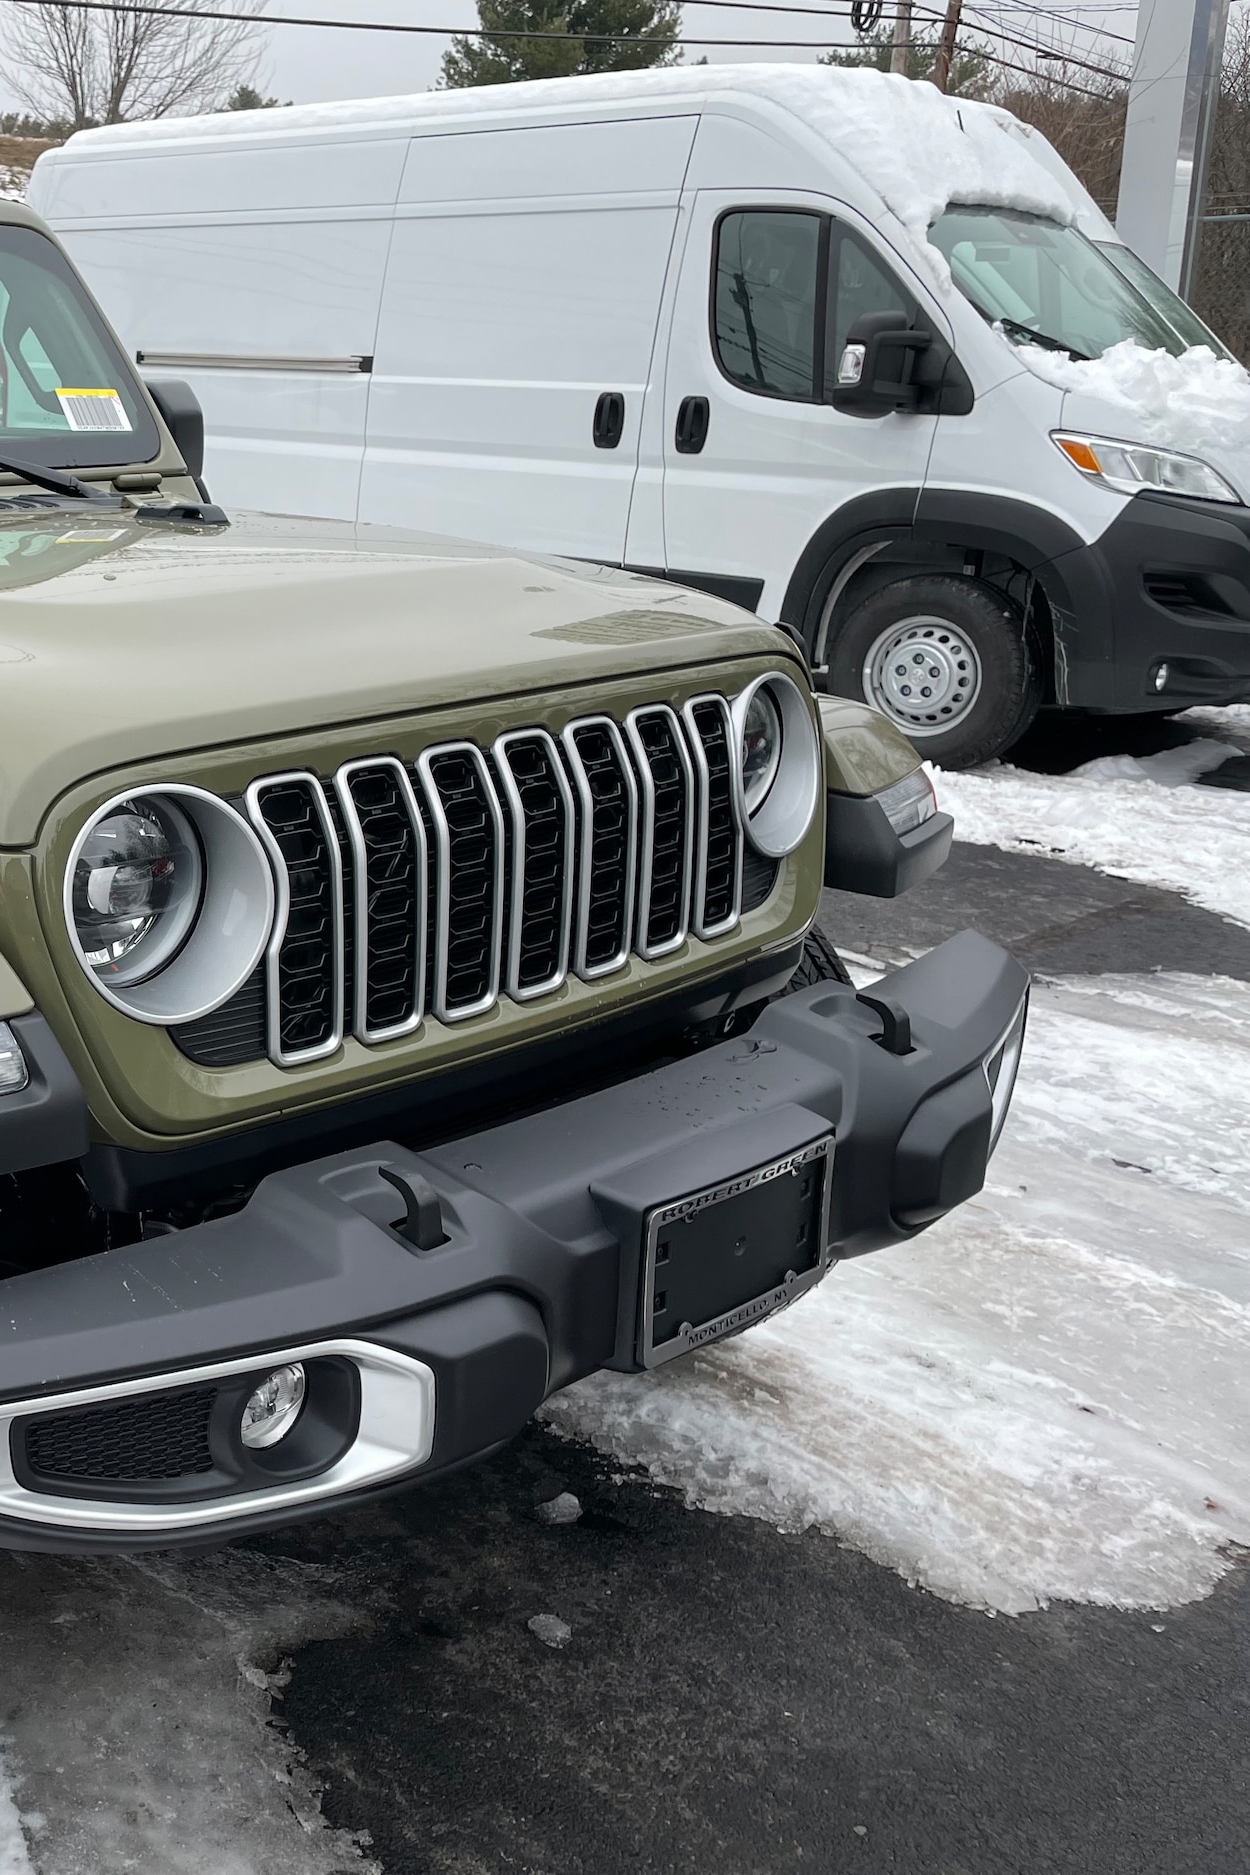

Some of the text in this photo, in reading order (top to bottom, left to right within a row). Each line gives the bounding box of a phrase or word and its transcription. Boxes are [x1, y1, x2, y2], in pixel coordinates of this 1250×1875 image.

[661, 1142, 828, 1222] ROBERT GREEN
[688, 1288, 789, 1346] MONTICELLO, NY
